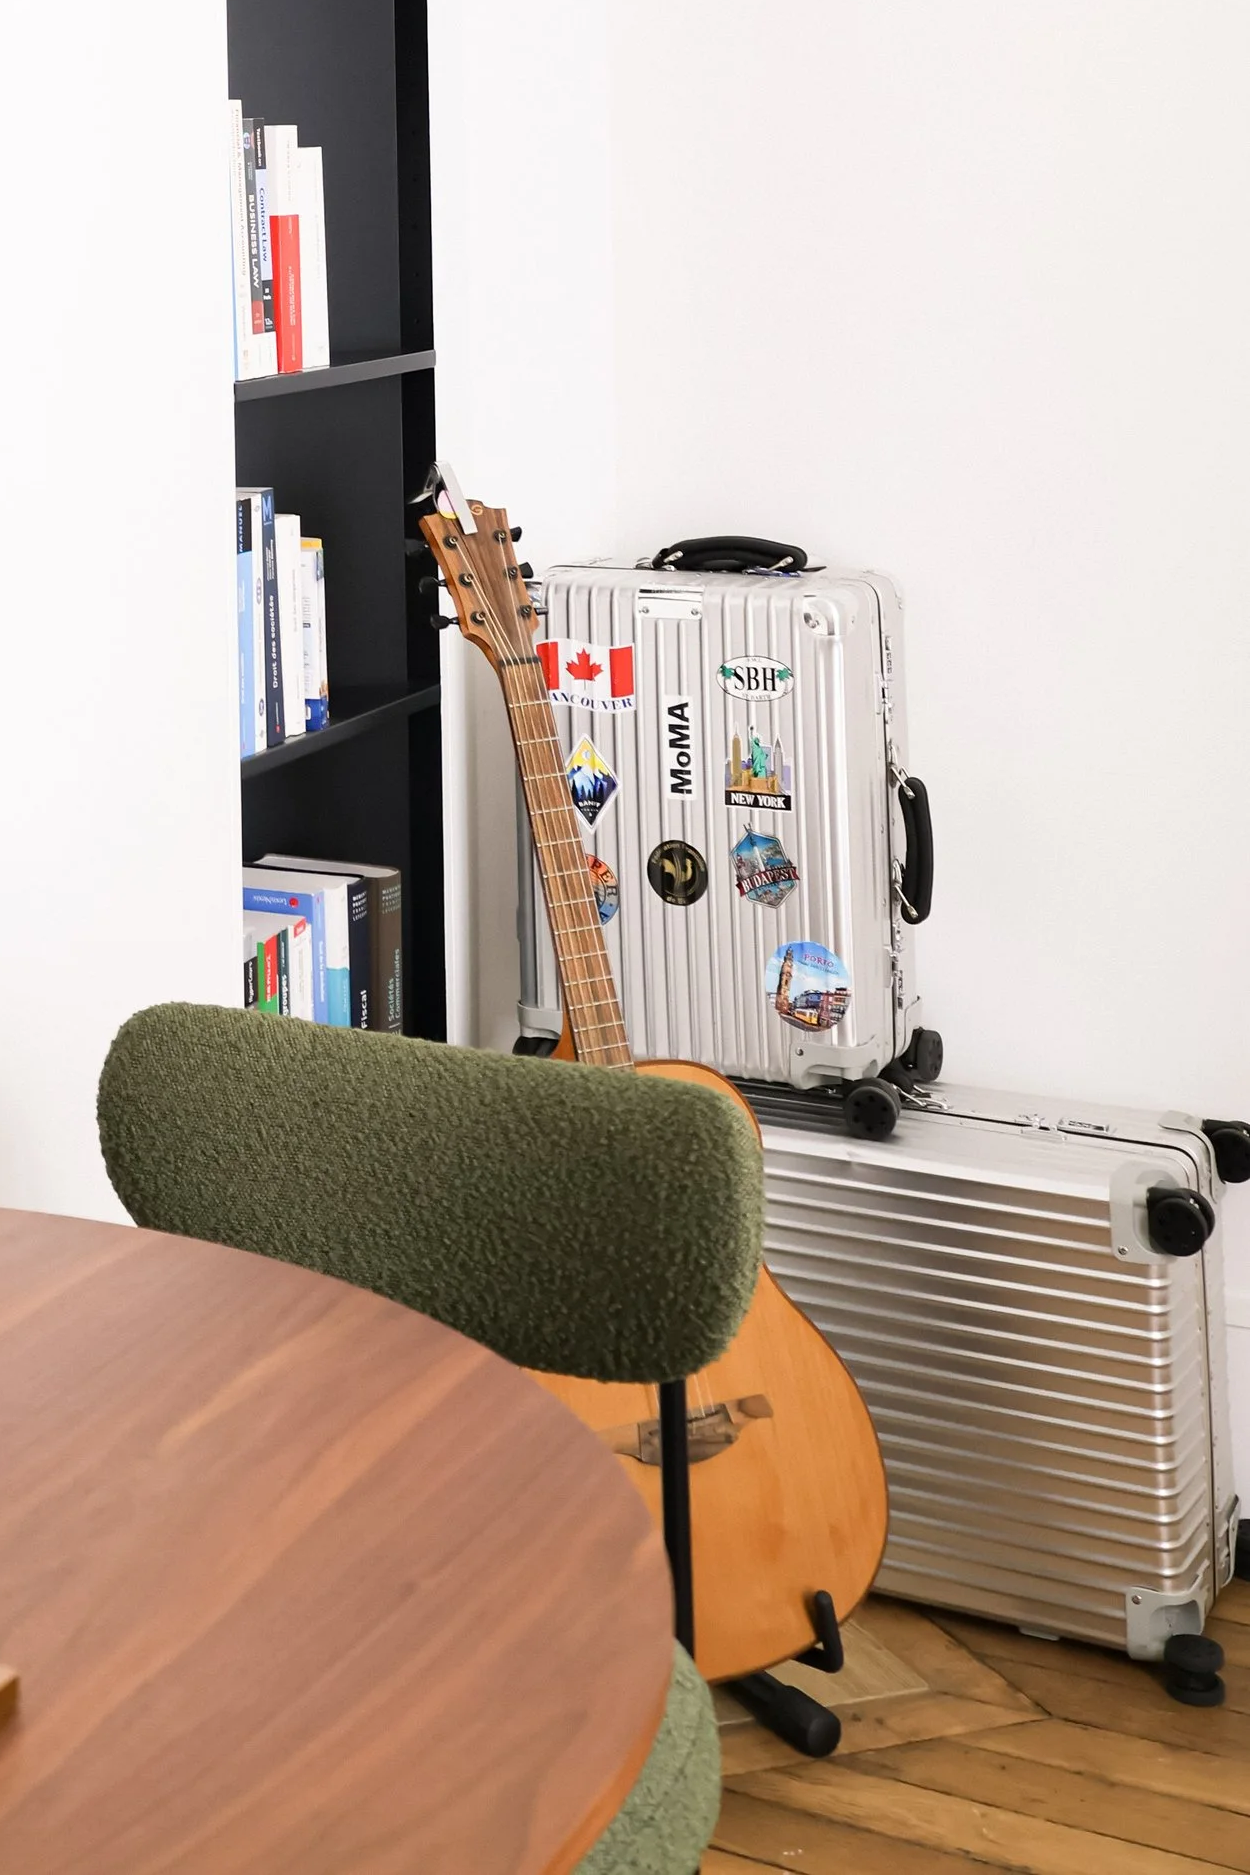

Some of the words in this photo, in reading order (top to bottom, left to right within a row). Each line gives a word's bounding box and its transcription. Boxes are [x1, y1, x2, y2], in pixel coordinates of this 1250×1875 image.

[248, 194, 258, 255] BUSINESS
[259, 187, 267, 237] Contract
[251, 257, 260, 289] LAW
[733, 665, 778, 692] SBH
[550, 692, 633, 711] ANCOUVER
[667, 702, 692, 794] MoMA
[731, 792, 754, 806] NEW
[756, 795, 786, 808] YORK
[741, 867, 797, 893] BUDAPEST
[803, 953, 834, 968] PORTO
